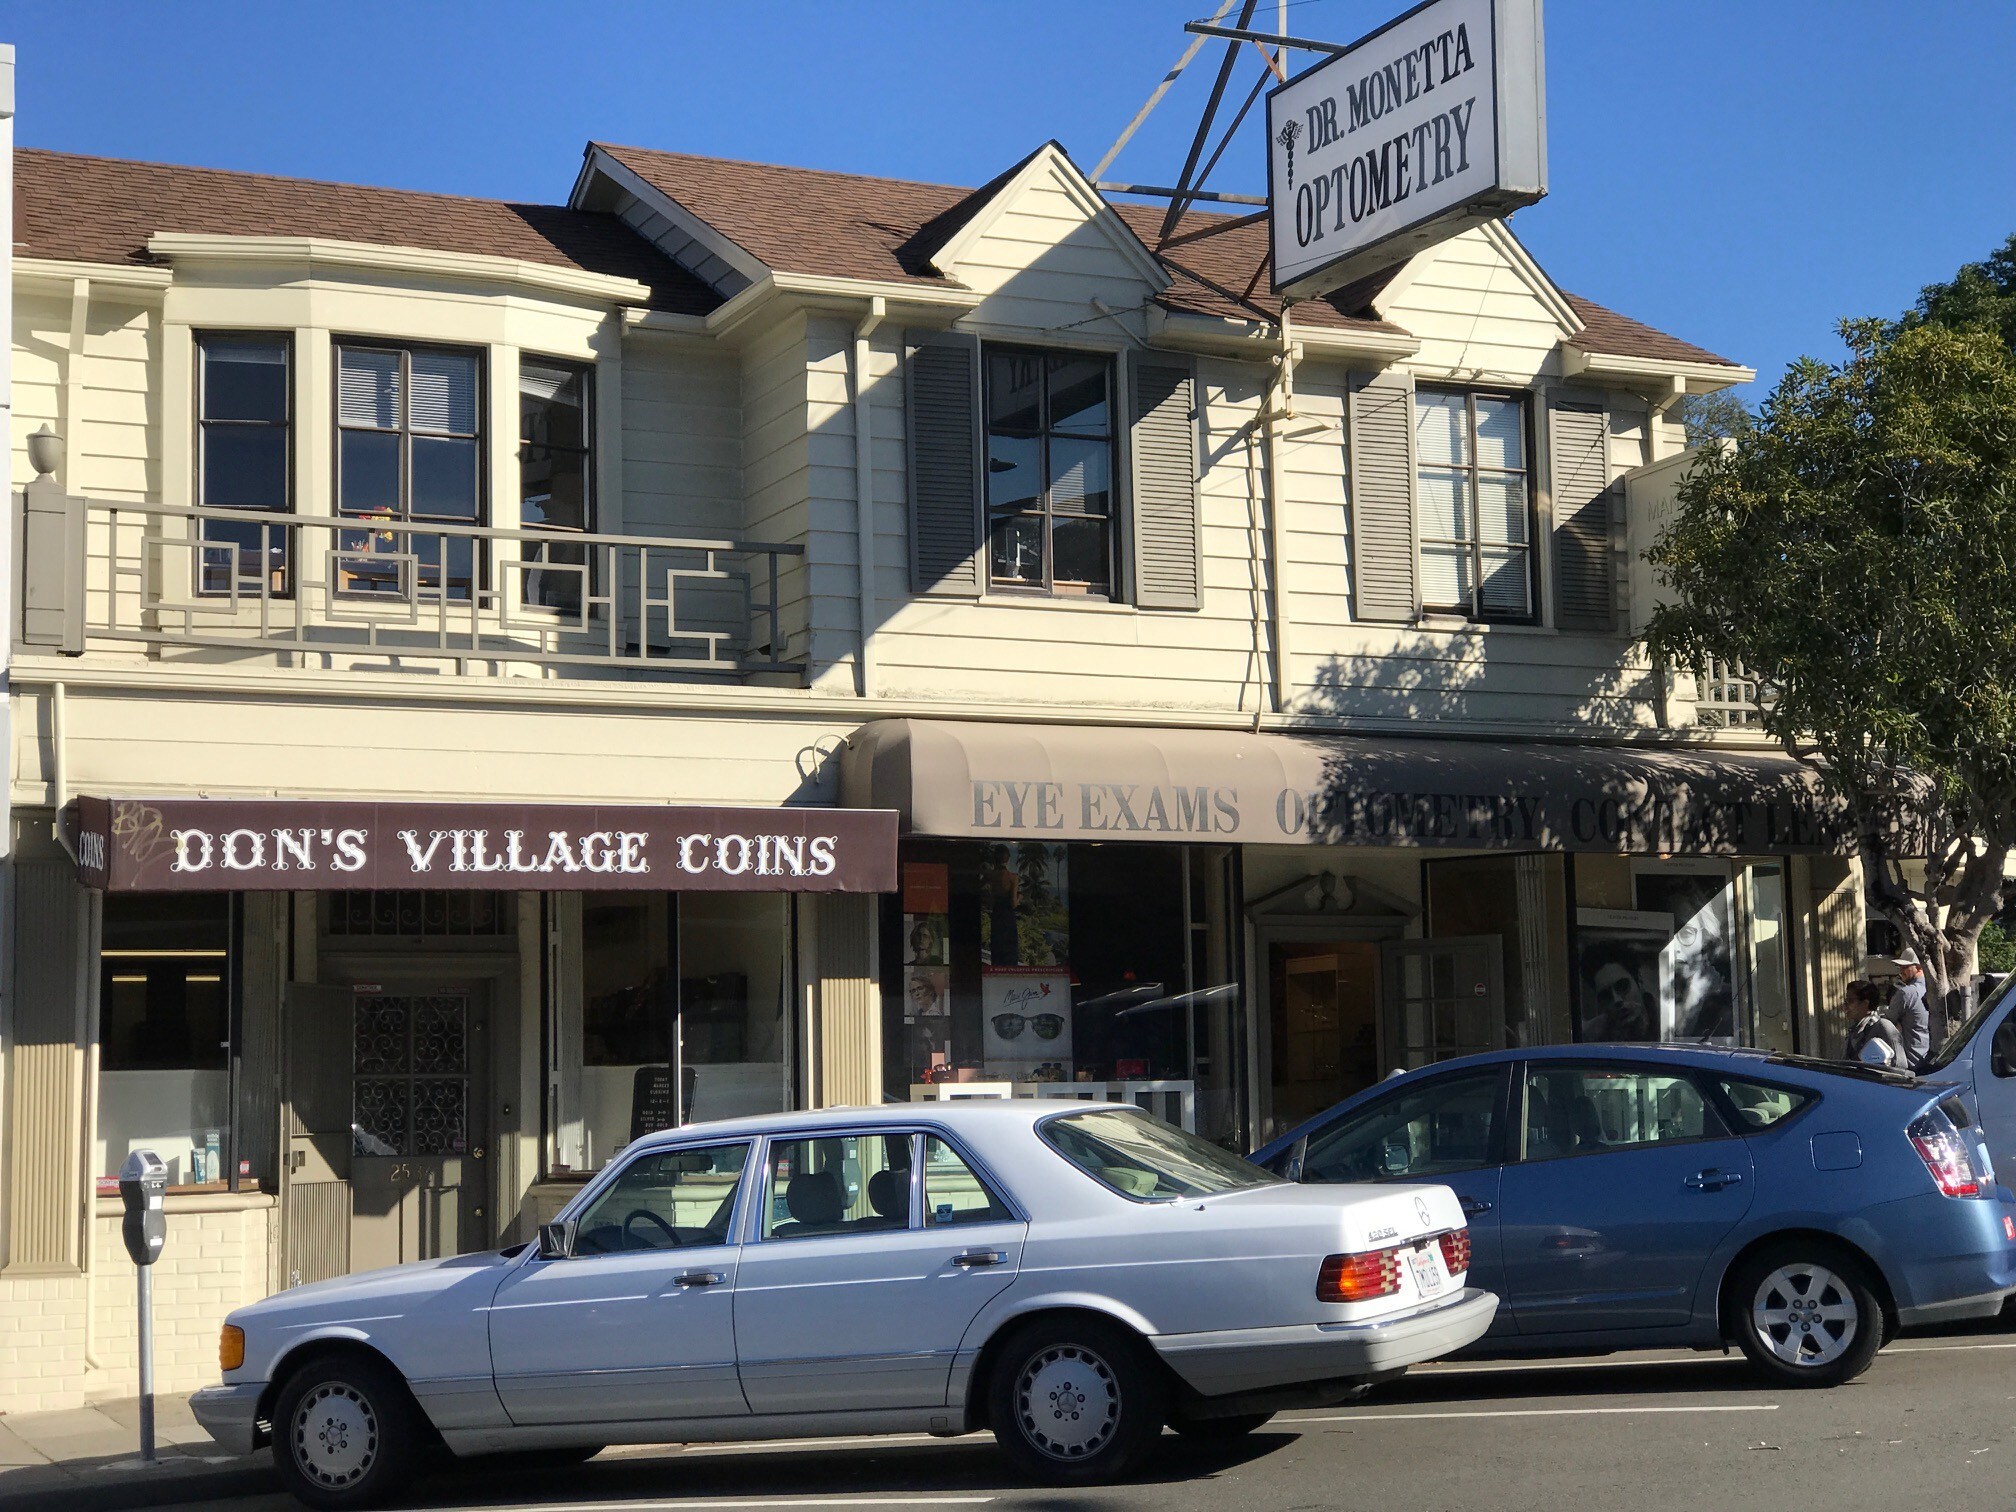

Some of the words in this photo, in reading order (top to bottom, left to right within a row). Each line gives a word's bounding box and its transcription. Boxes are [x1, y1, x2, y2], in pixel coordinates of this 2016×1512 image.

[1305, 96, 1345, 155] DR.
[1346, 22, 1475, 133] MONETTA
[1296, 96, 1476, 248] OPTOMETRY
[970, 780, 1064, 830] EYE
[1078, 783, 1241, 834] EXAMS
[1276, 788, 1541, 841] OPTOMETRY
[79, 830, 104, 872] COINS
[170, 828, 368, 873] DON'S
[397, 829, 651, 874] VILLAGE
[676, 833, 838, 877] COINS
